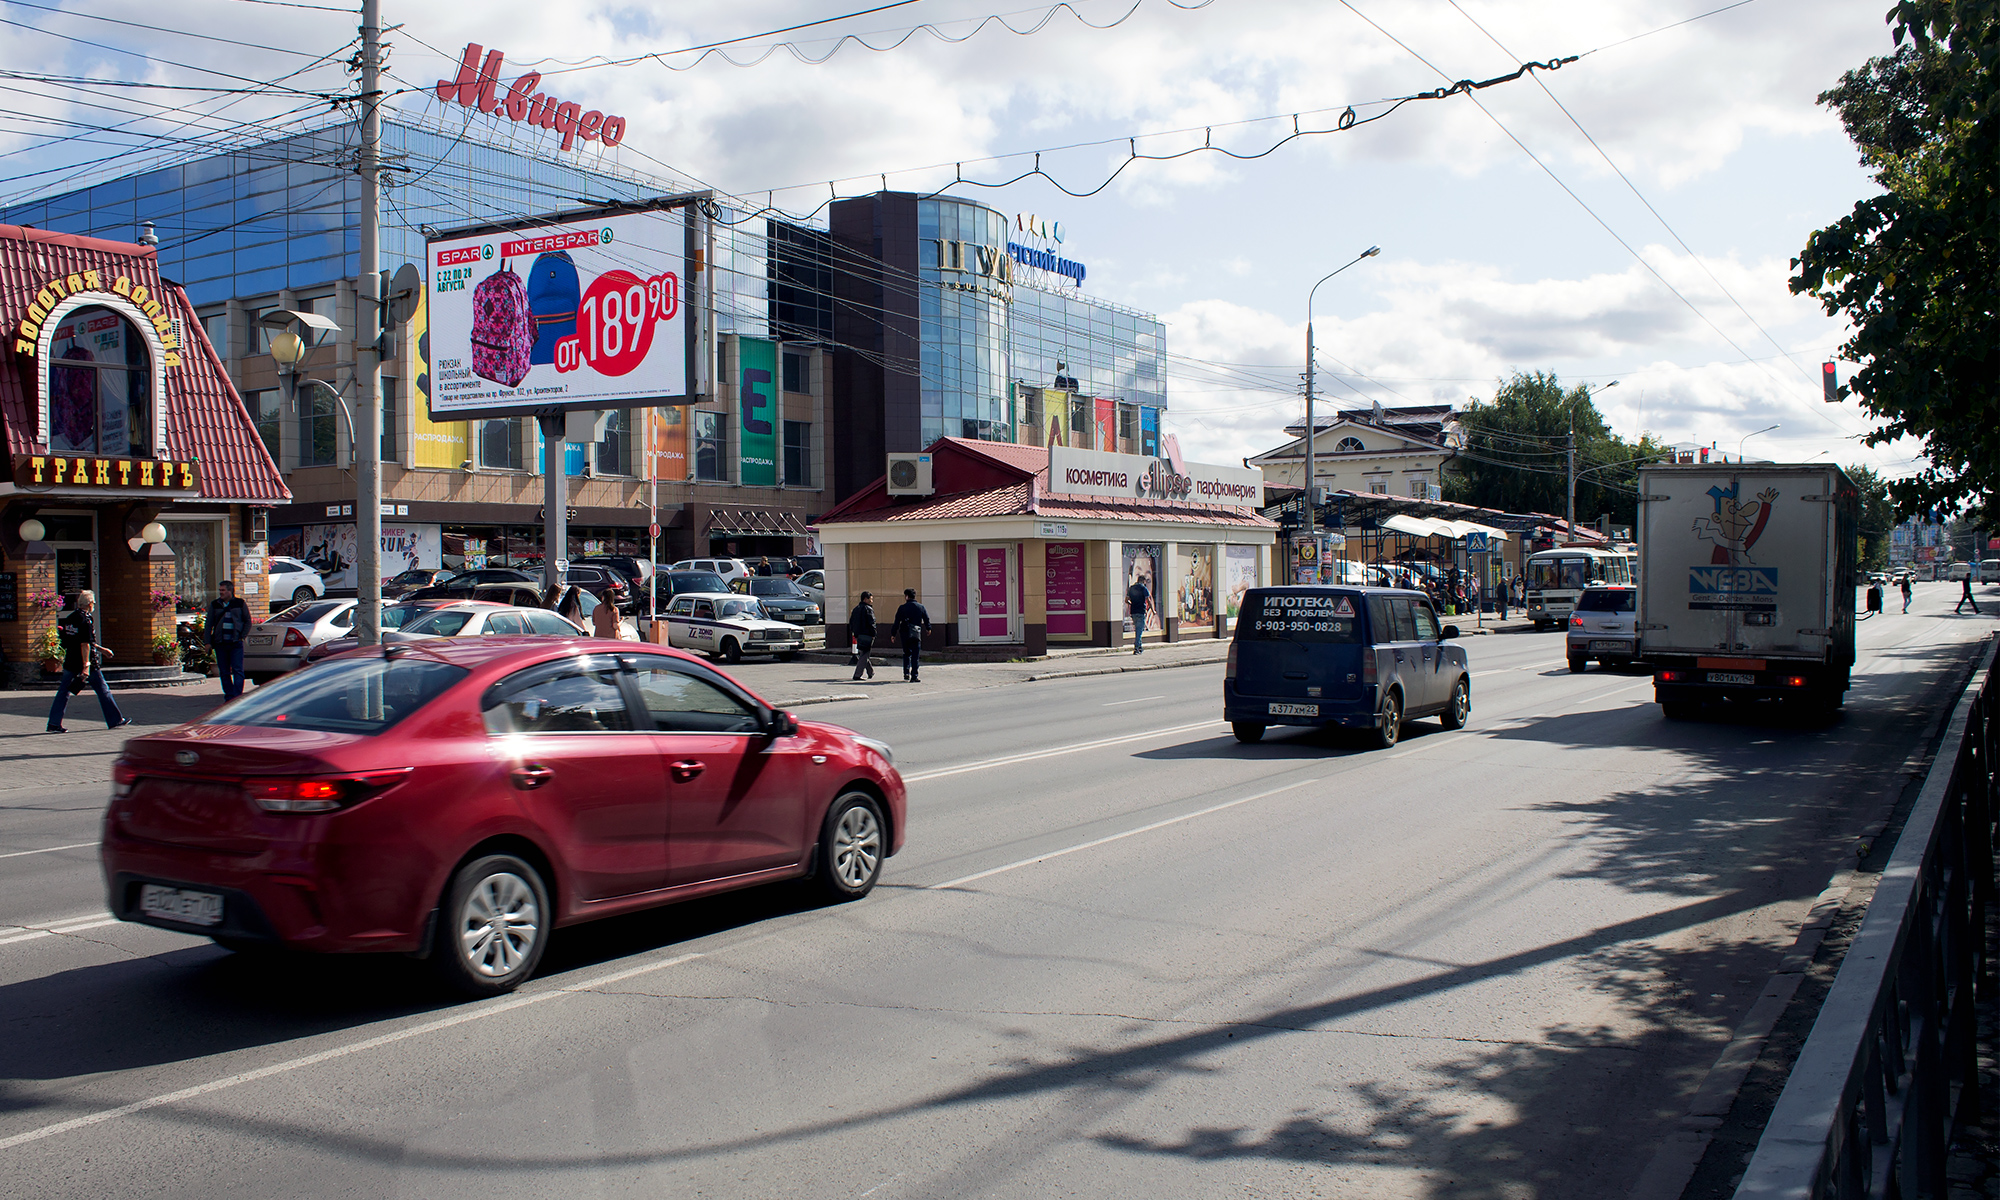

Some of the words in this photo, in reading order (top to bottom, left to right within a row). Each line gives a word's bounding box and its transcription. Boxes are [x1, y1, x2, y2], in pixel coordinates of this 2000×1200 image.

[437, 42, 626, 151] М.видео
[510, 232, 598, 254] INTERSPAR
[441, 248, 480, 264] SPAR
[1008, 241, 1056, 273] етский
[1058, 257, 1086, 287] мир
[443, 270, 452, 281] 22
[453, 268, 462, 279] ПО
[463, 267, 472, 278] 28
[437, 280, 466, 293] АВГУСТА
[16, 270, 100, 357] ЗОЛОТАЯ
[113, 276, 181, 367] ДОЛИНА
[583, 285, 646, 361] 189
[648, 277, 674, 319] 90
[438, 359, 462, 370] РЮКЗАК
[444, 380, 481, 391] ассортименте
[414, 433, 464, 444] РАСПРОДАЖА
[646, 450, 685, 460] РАПРОДАЖА
[30, 457, 194, 487] ТРАКТИРЪ
[1065, 467, 1128, 488] косметика
[1139, 461, 1192, 499] ellipse
[1196, 478, 1256, 502] парфюмерия
[381, 528, 406, 537] НИКЕР
[1690, 568, 1778, 592] WEBA
[1264, 596, 1334, 608] ИПОТЕКА
[1752, 595, 1773, 603] Mons
[1263, 608, 1281, 617] БЕЗ
[1287, 609, 1335, 617] ПРОБЛЕМ
[1255, 620, 1342, 632] 8-903-950-0828
